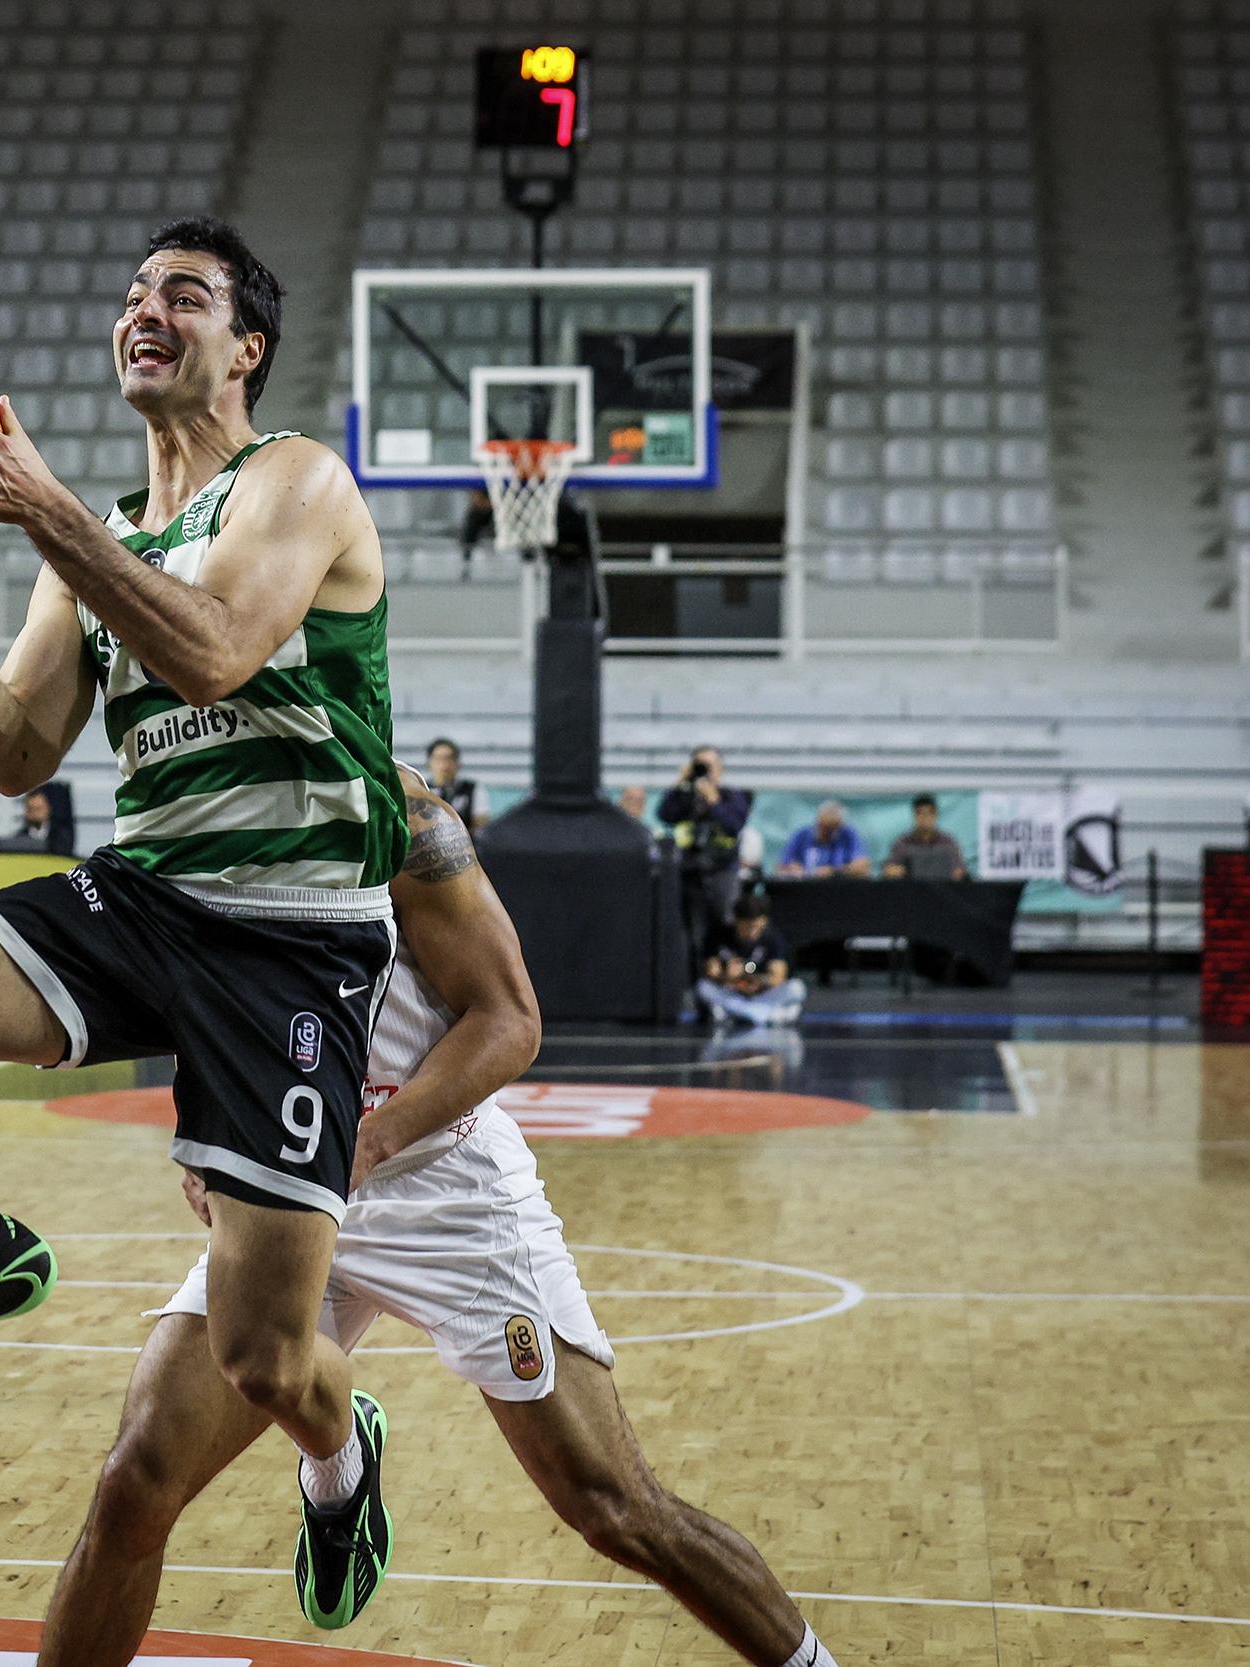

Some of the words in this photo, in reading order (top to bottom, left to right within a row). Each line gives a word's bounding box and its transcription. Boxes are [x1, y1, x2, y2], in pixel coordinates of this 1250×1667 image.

[540, 88, 575, 147] 7
[137, 707, 249, 758] Buildity.
[279, 1085, 323, 1164] 9
